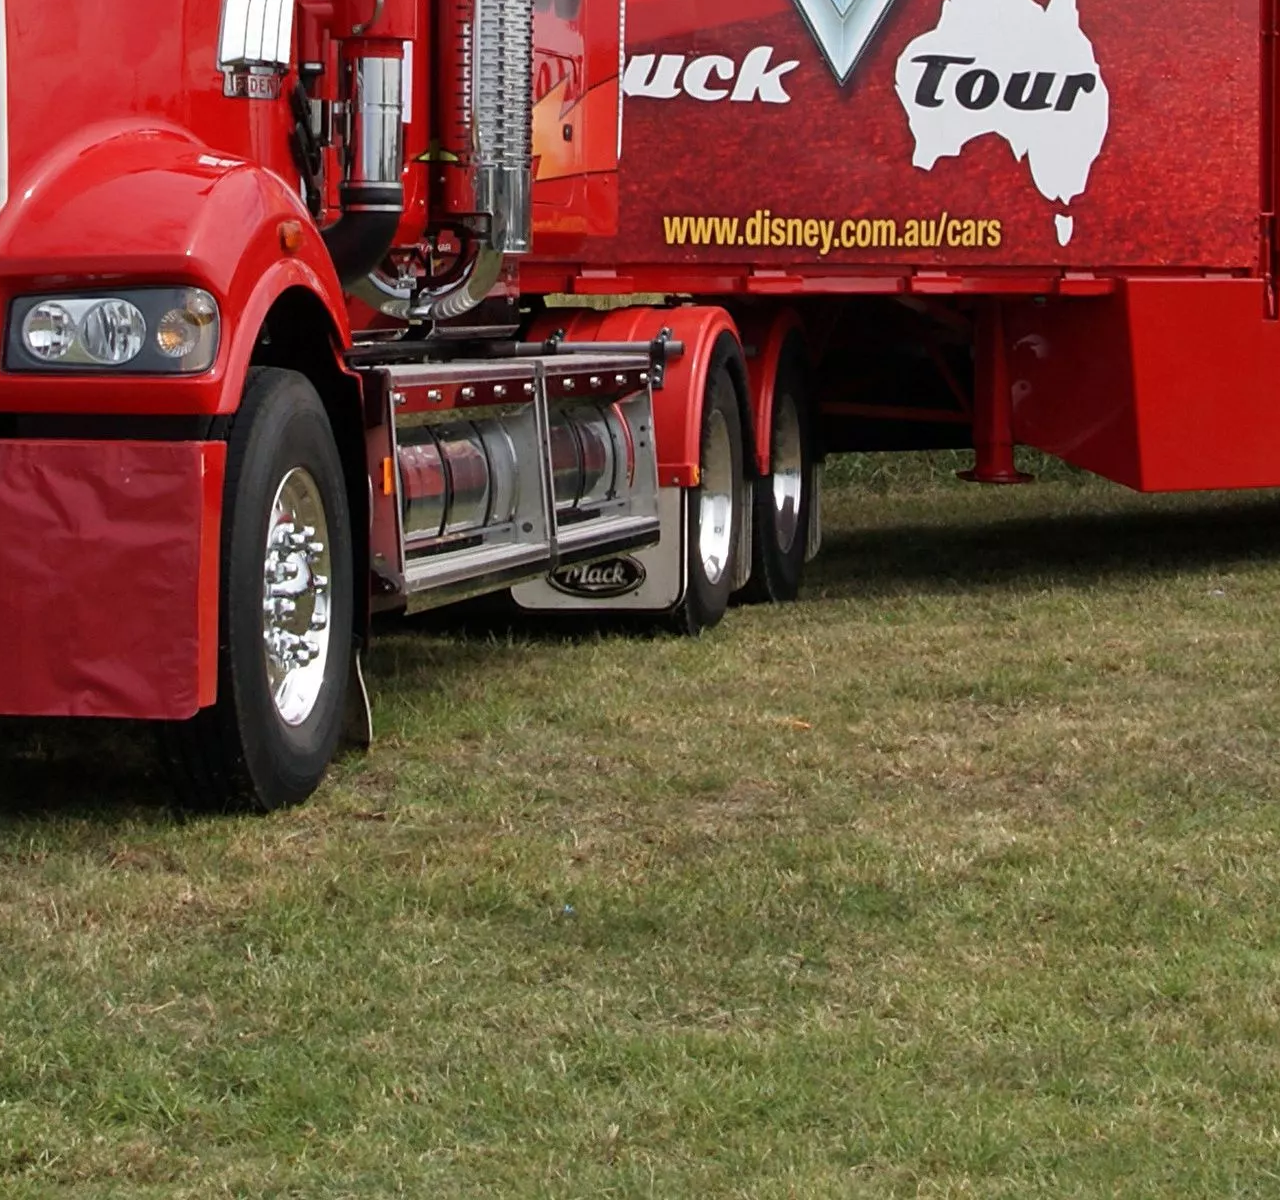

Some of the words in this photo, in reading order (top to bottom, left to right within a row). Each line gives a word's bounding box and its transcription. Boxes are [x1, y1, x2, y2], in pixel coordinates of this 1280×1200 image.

[622, 46, 800, 104] uck
[910, 54, 1096, 112] Tour
[664, 209, 1002, 254] www.disney.com.au/cars
[565, 562, 625, 584] Mack
